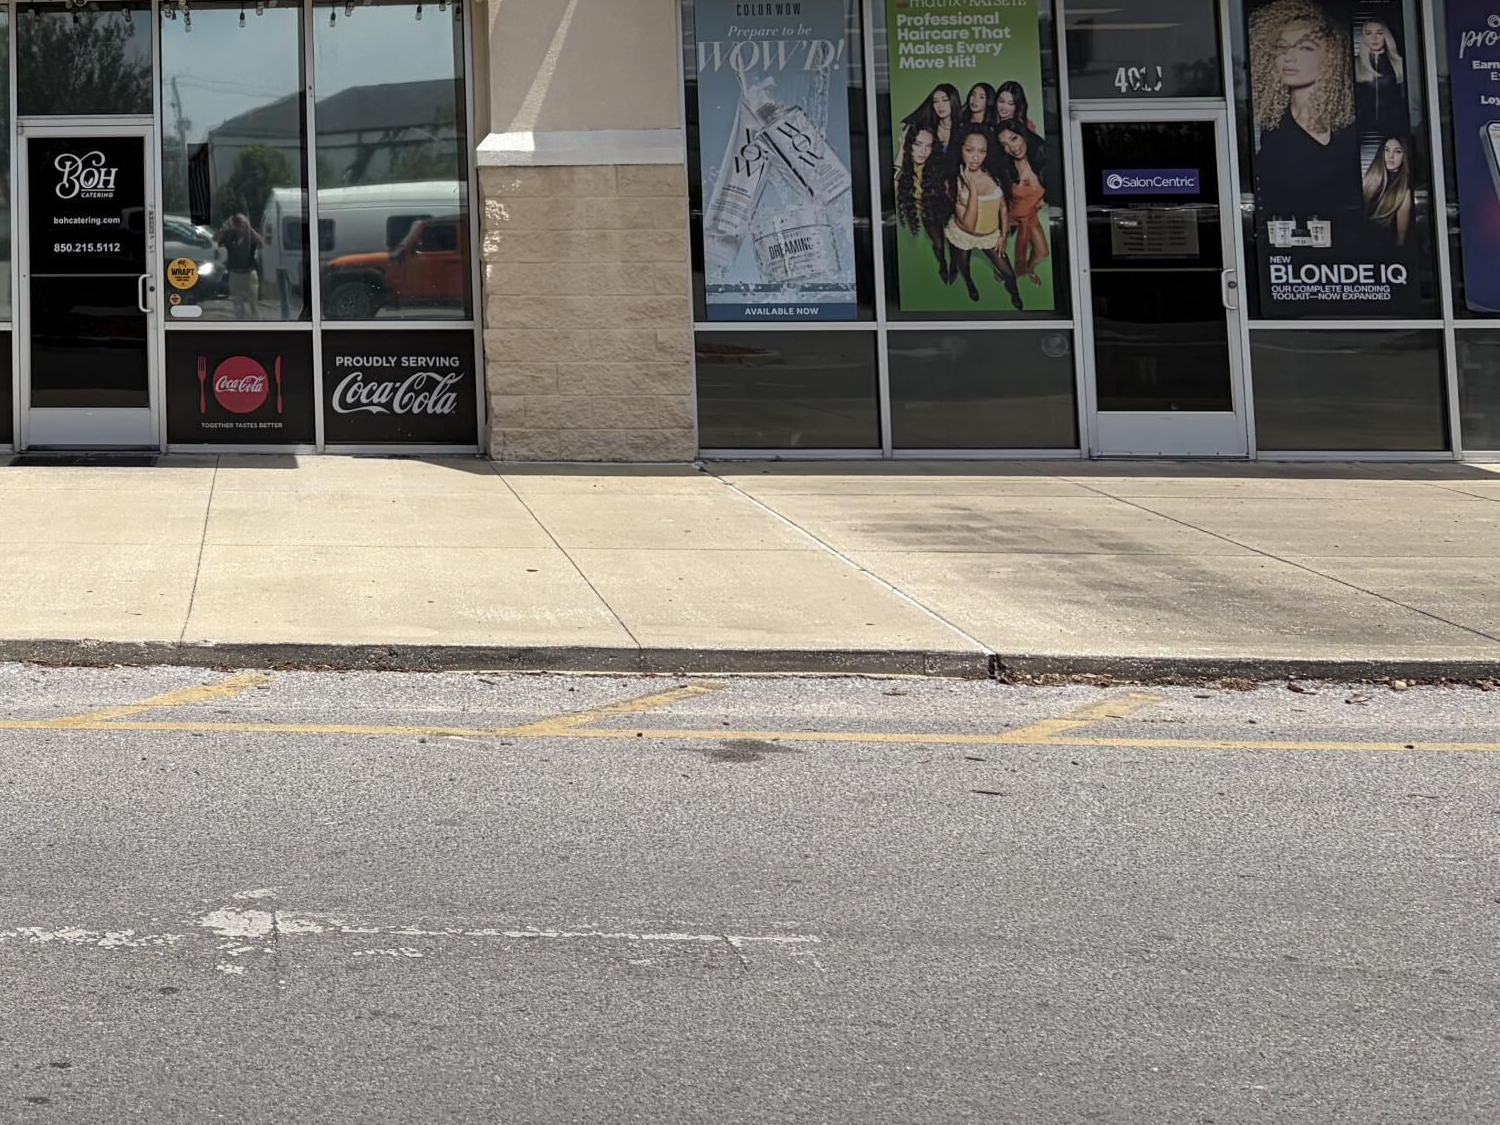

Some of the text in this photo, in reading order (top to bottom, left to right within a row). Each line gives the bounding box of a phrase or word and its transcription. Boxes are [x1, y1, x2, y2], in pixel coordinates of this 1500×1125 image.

[736, 2, 801, 16] COLOR WOW
[896, 11, 1000, 26] Professional
[727, 23, 812, 40] Prepare to be
[897, 26, 1011, 40] Haircare That
[697, 38, 845, 72] WOW'D!
[898, 42, 1003, 56] Makes Every
[900, 55, 977, 69] Move Hit!
[54, 150, 118, 199] BOH
[1122, 176, 1195, 187] SalonCentric
[54, 216, 120, 225] bohcatering.com
[54, 243, 120, 253] 850.215.5112
[1270, 263, 1407, 285] BLONDE IQ
[1271, 285, 1391, 293] OUR COMPLETE BLONDING
[1342, 292, 1391, 300] EXPANDED
[745, 307, 819, 315] AVAILABLE NOW
[335, 356, 460, 367] PROUDLY SERVING
[215, 375, 267, 393] Coca-Cola
[332, 372, 465, 414] Coca-Cola
